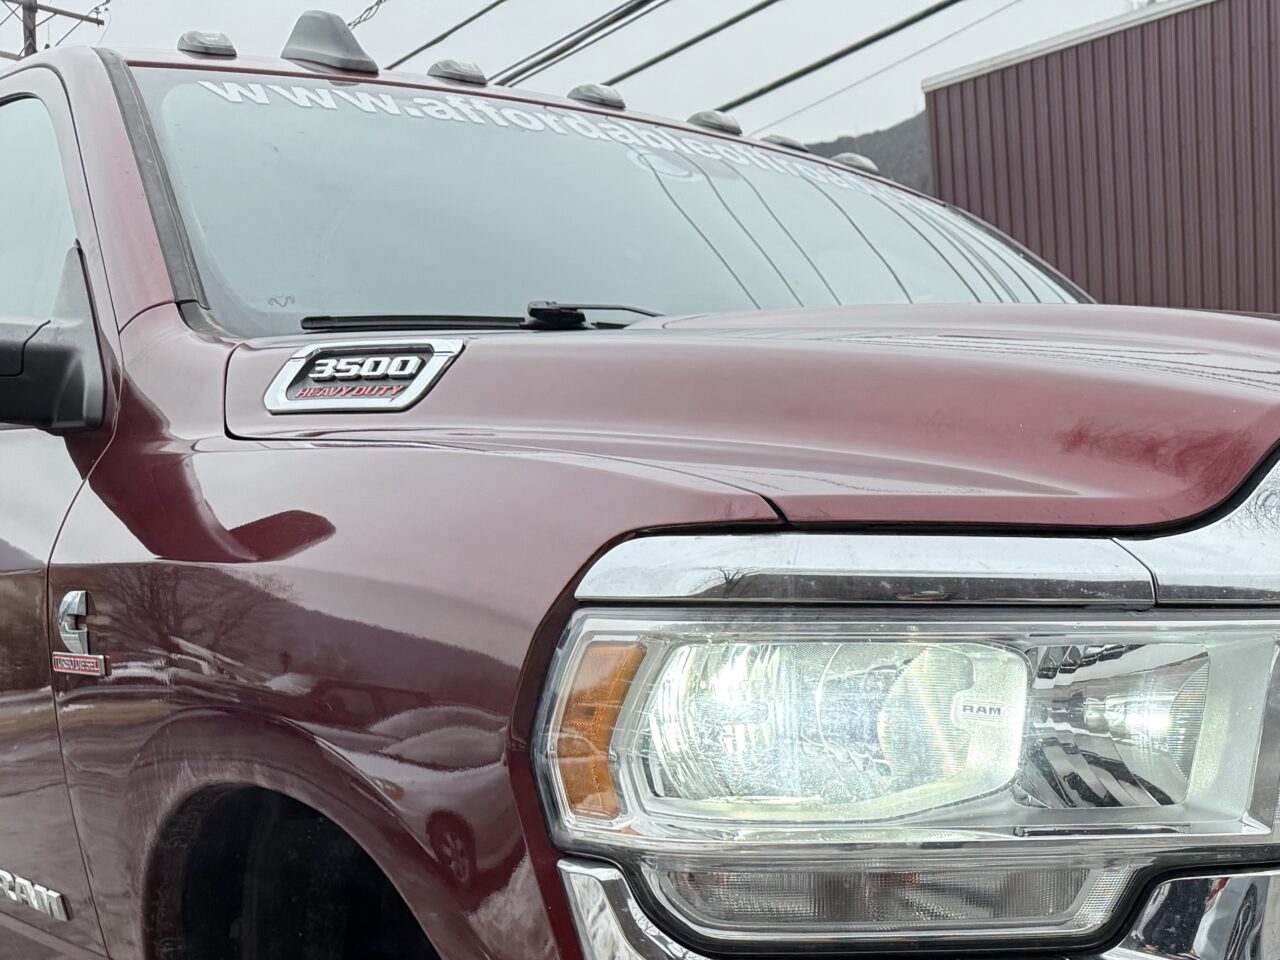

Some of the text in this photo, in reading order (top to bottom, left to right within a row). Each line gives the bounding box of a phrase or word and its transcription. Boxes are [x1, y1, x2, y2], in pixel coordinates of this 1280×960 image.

[308, 356, 423, 382] 3500
[295, 385, 406, 398] HEAVY DUTY
[962, 704, 1002, 715] RAM
